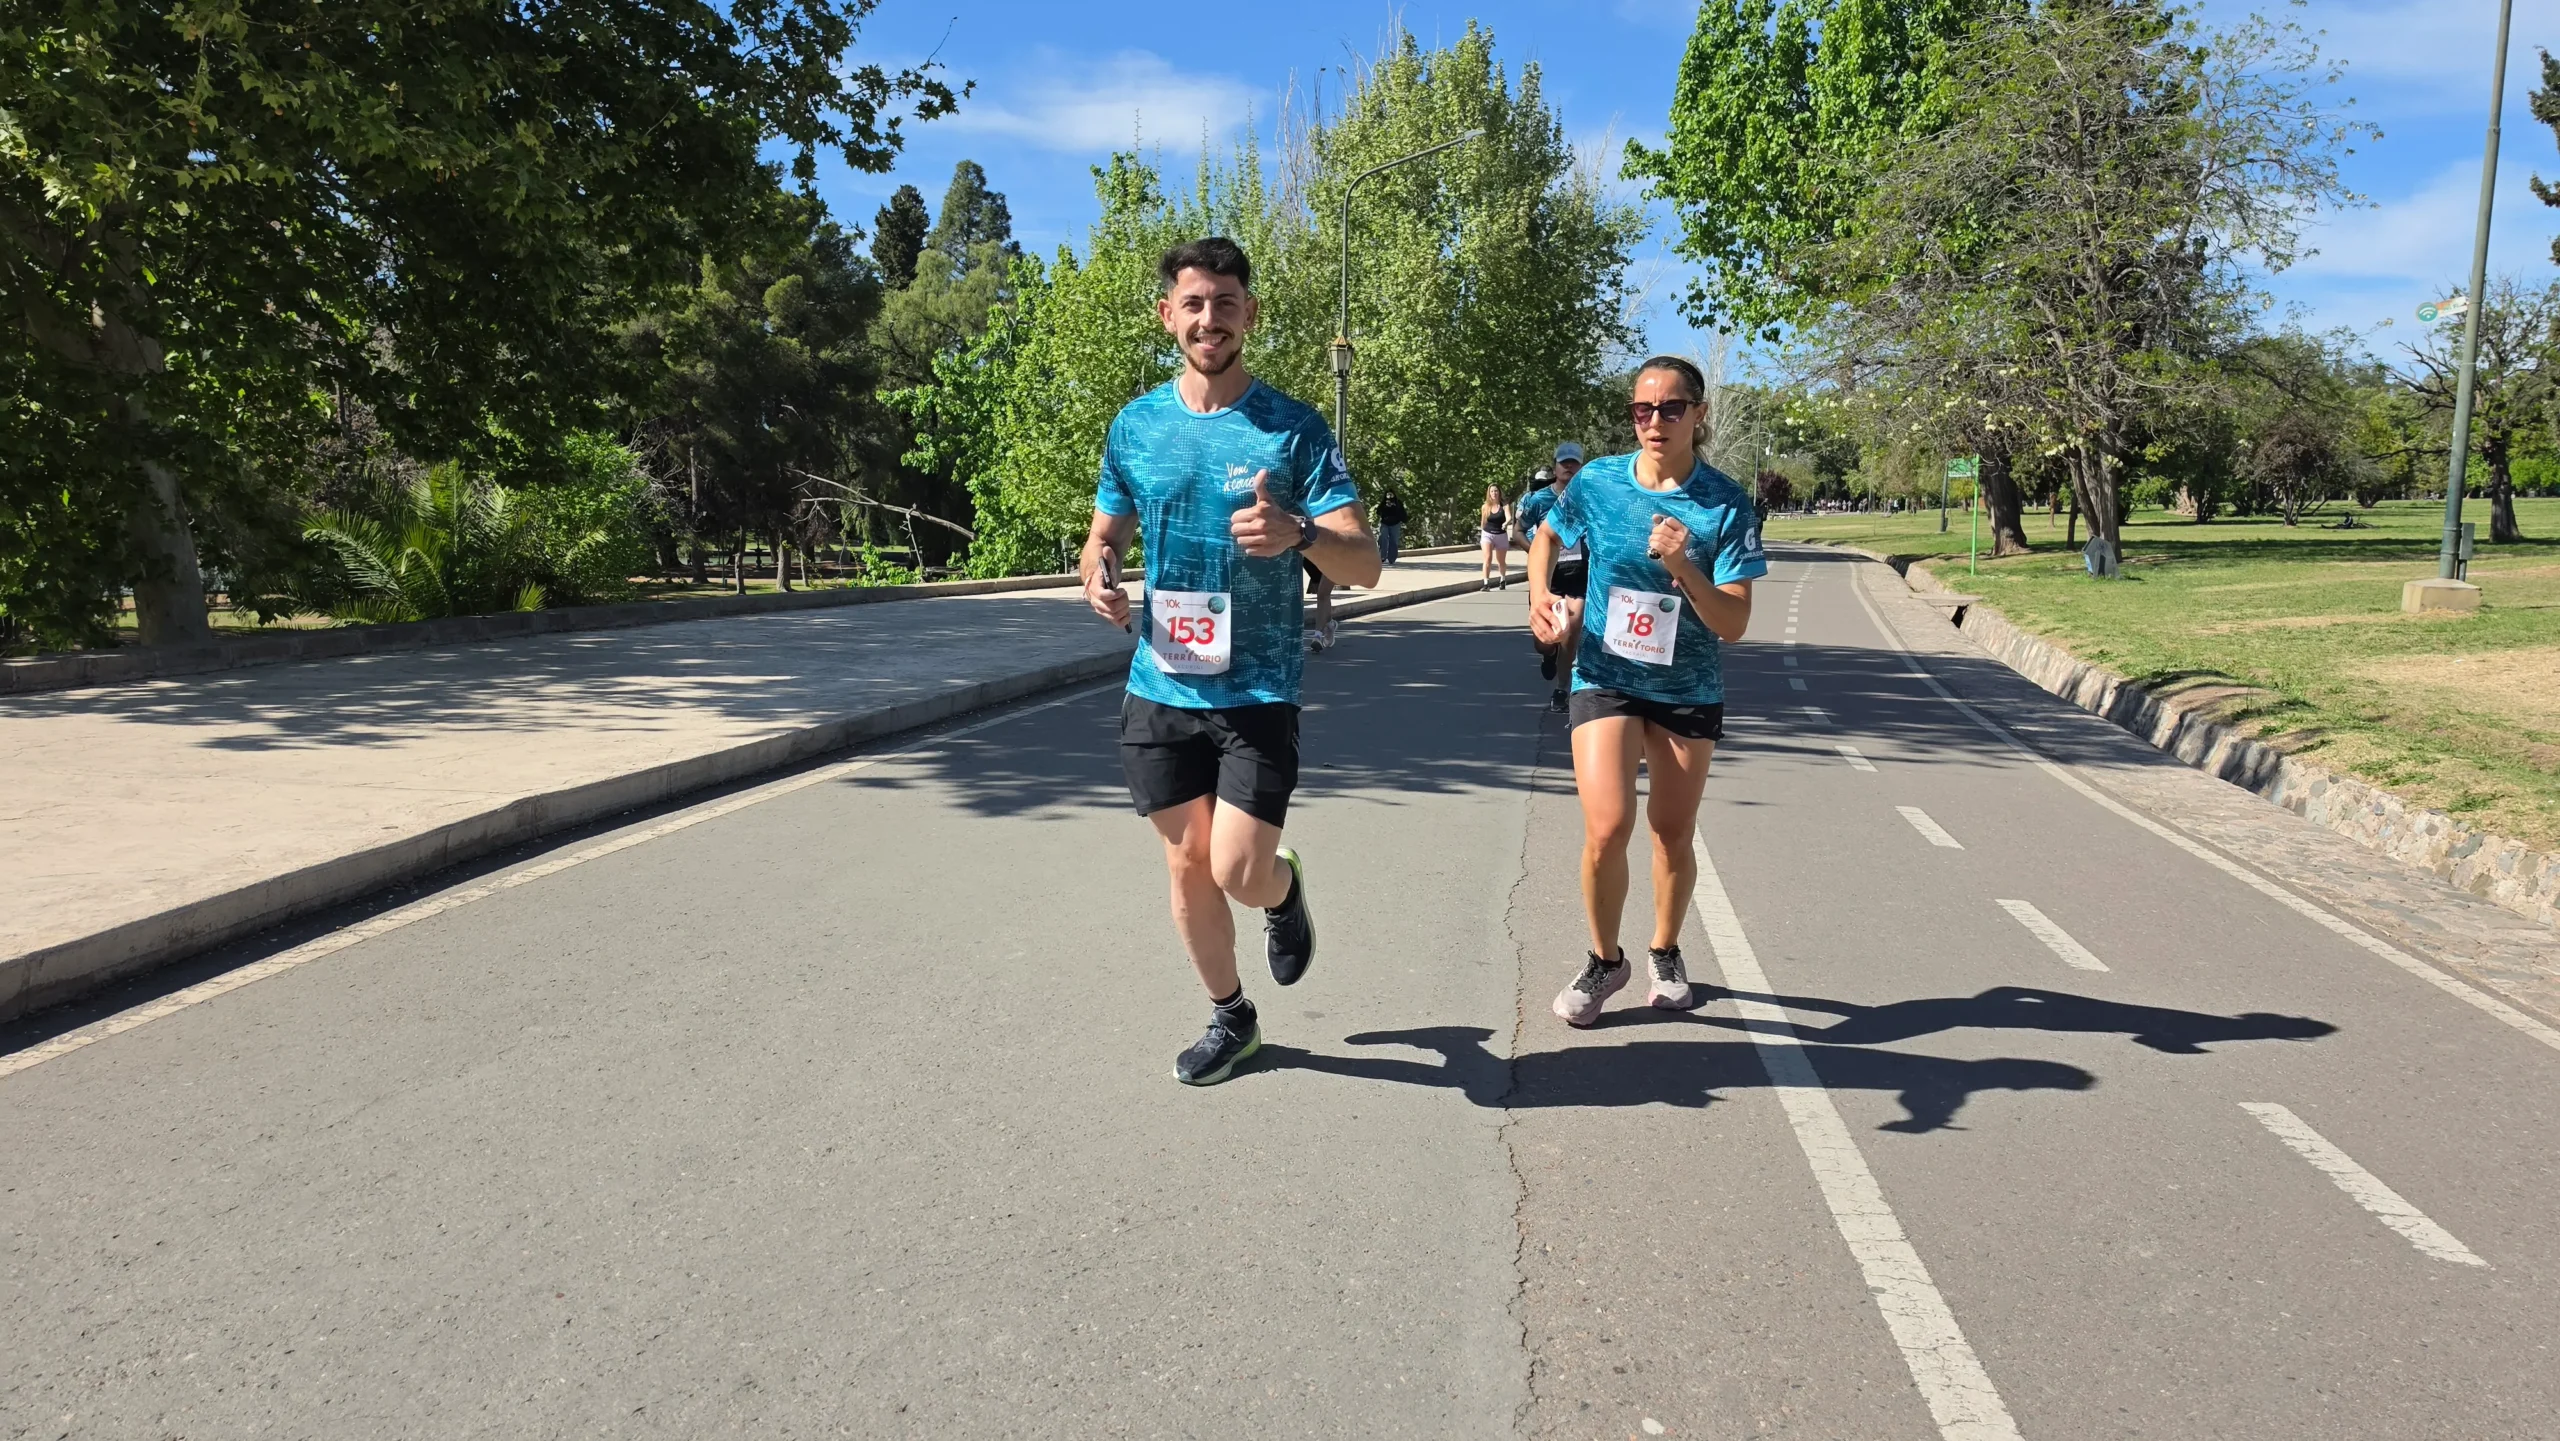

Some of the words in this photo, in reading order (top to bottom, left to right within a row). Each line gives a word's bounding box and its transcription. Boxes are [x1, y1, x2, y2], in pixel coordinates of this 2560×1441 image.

[1231, 476, 1255, 490] corre
[1165, 599, 1180, 608] 10k
[1621, 594, 1635, 605] 10k
[1167, 616, 1215, 645] 153
[1627, 612, 1655, 637] 18
[1613, 638, 1666, 654] TERRITORIO
[1163, 650, 1221, 663] TERRITORIO
